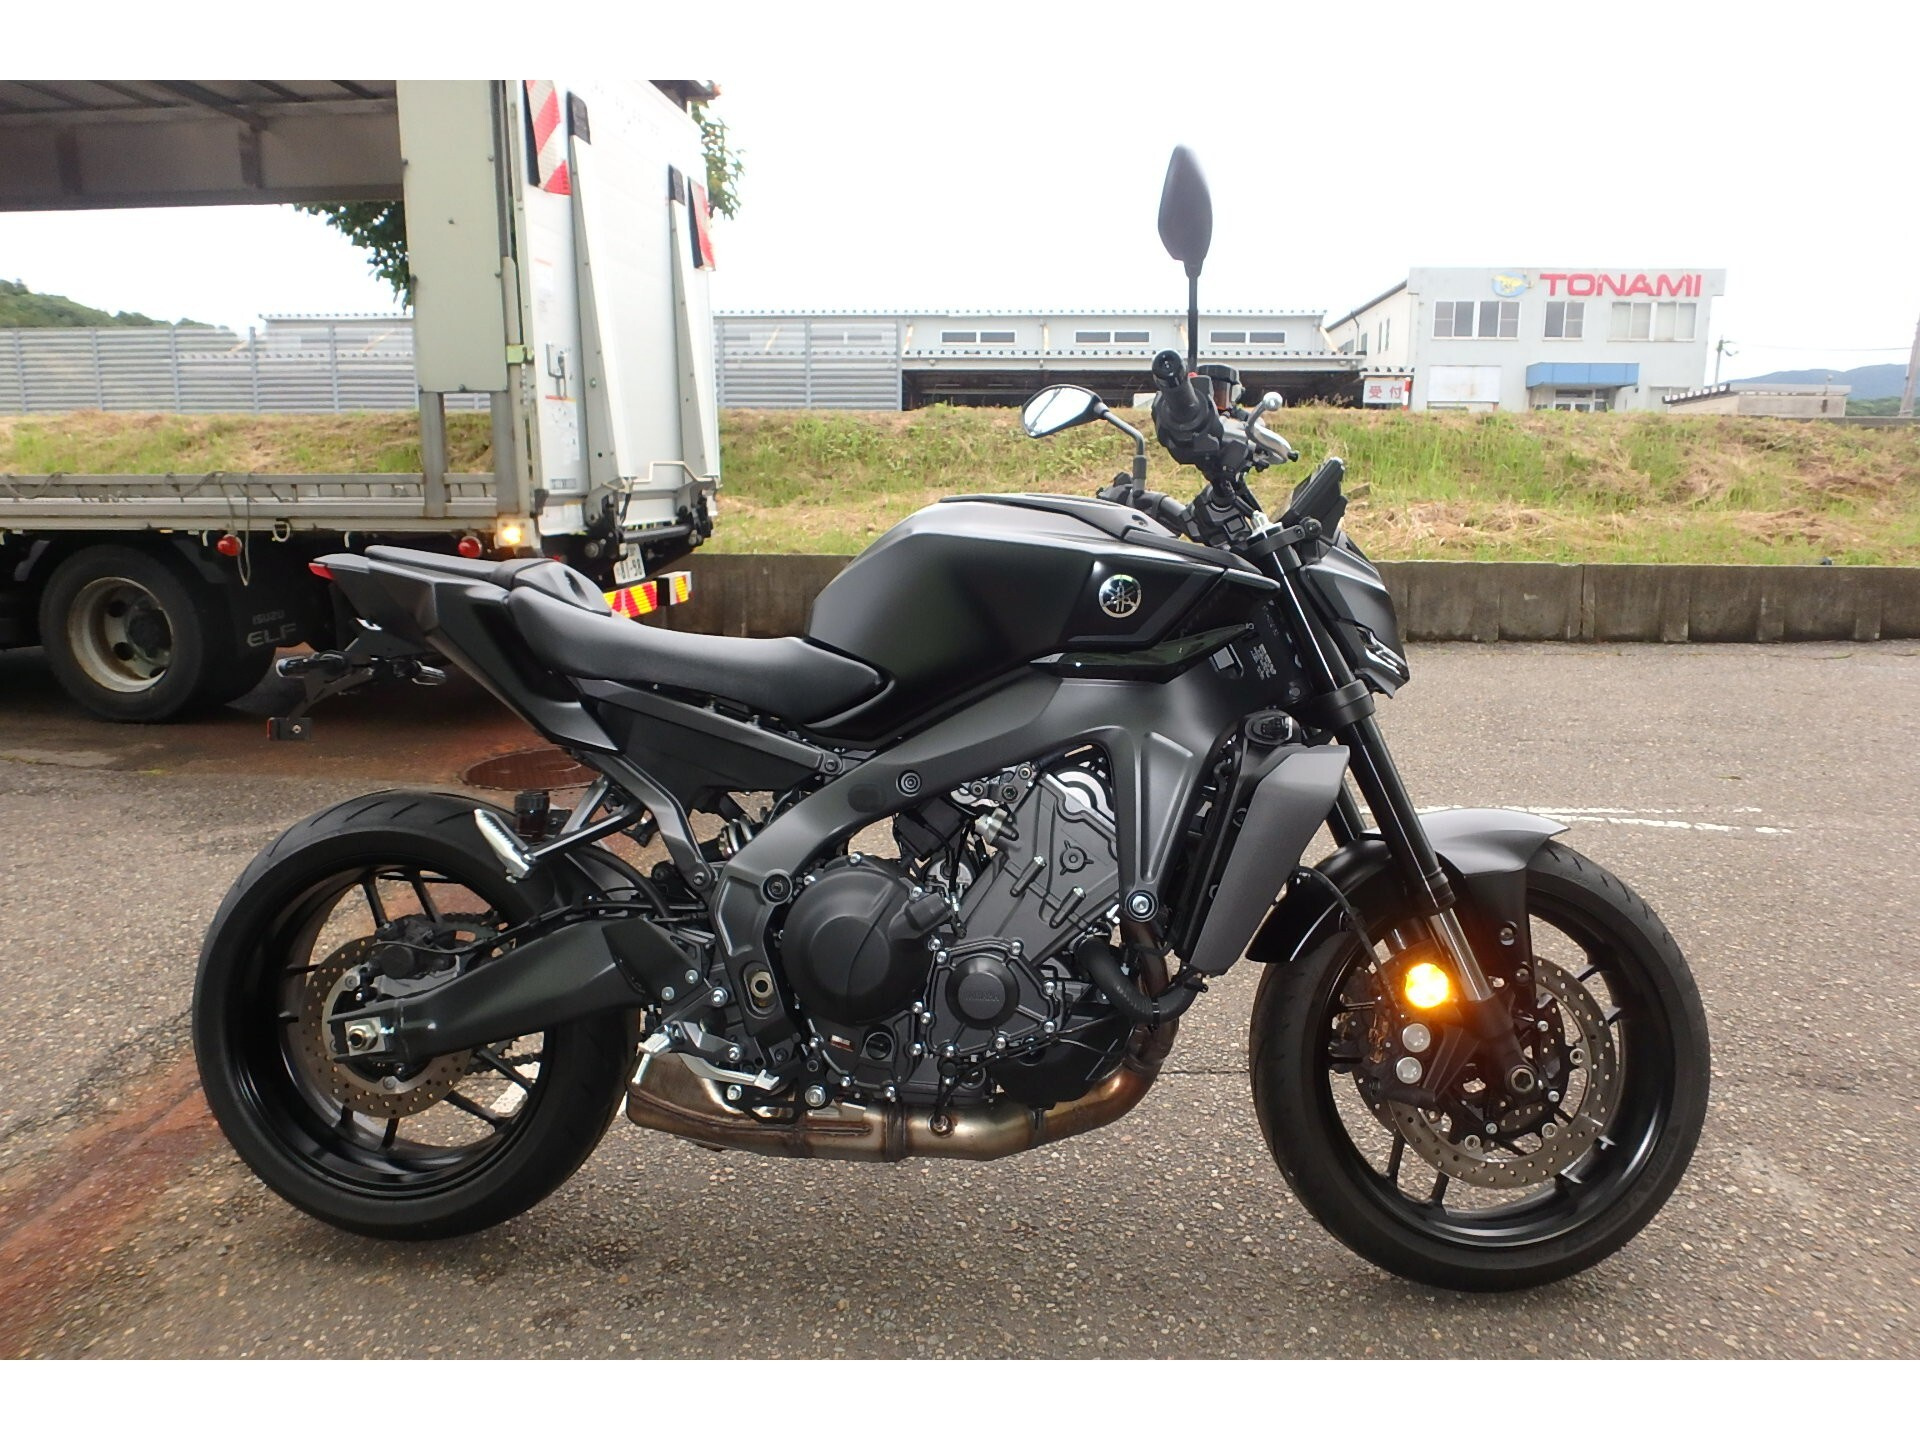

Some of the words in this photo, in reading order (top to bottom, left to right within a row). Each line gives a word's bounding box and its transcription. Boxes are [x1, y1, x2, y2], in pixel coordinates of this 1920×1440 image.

[1539, 272, 1702, 297] TONAMI
[1368, 385, 1402, 399] 受付
[252, 609, 285, 625] ISUZU
[247, 623, 297, 648] ELF
